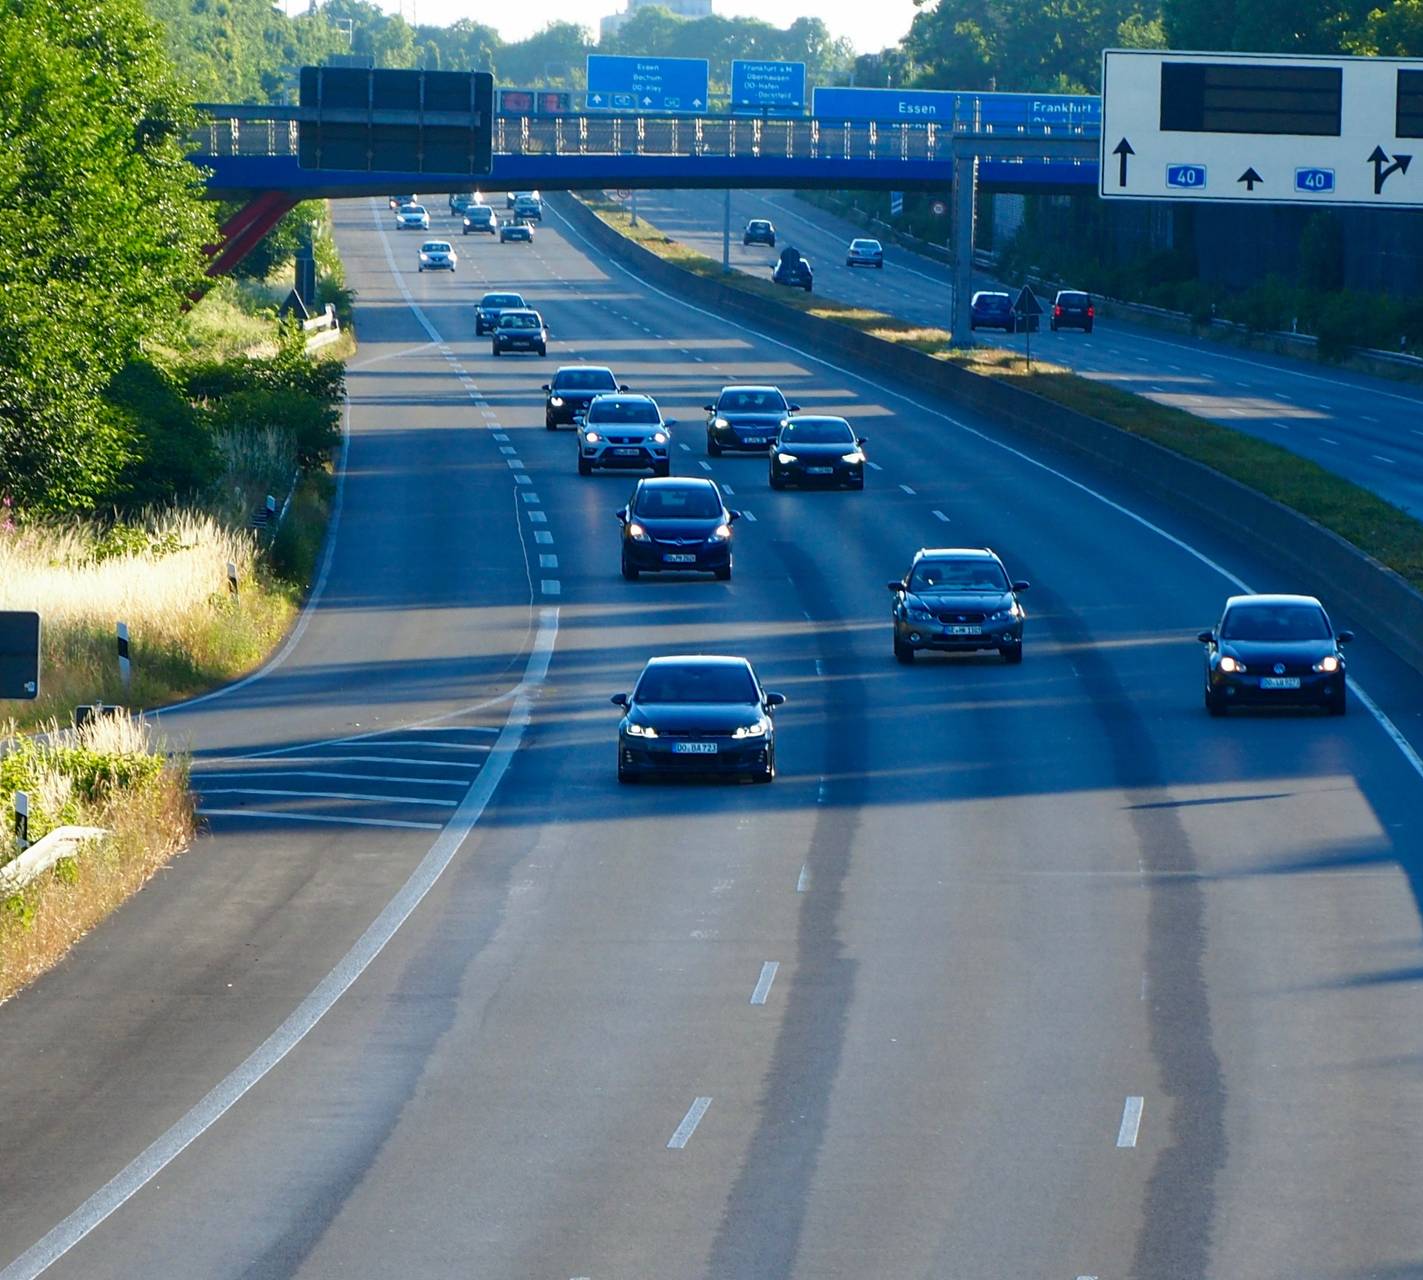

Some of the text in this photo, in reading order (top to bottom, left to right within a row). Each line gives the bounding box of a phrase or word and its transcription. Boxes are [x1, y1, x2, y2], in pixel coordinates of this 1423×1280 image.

[898, 101, 936, 115] Essen
[1177, 169, 1196, 184] 40
[1305, 173, 1325, 188] 40
